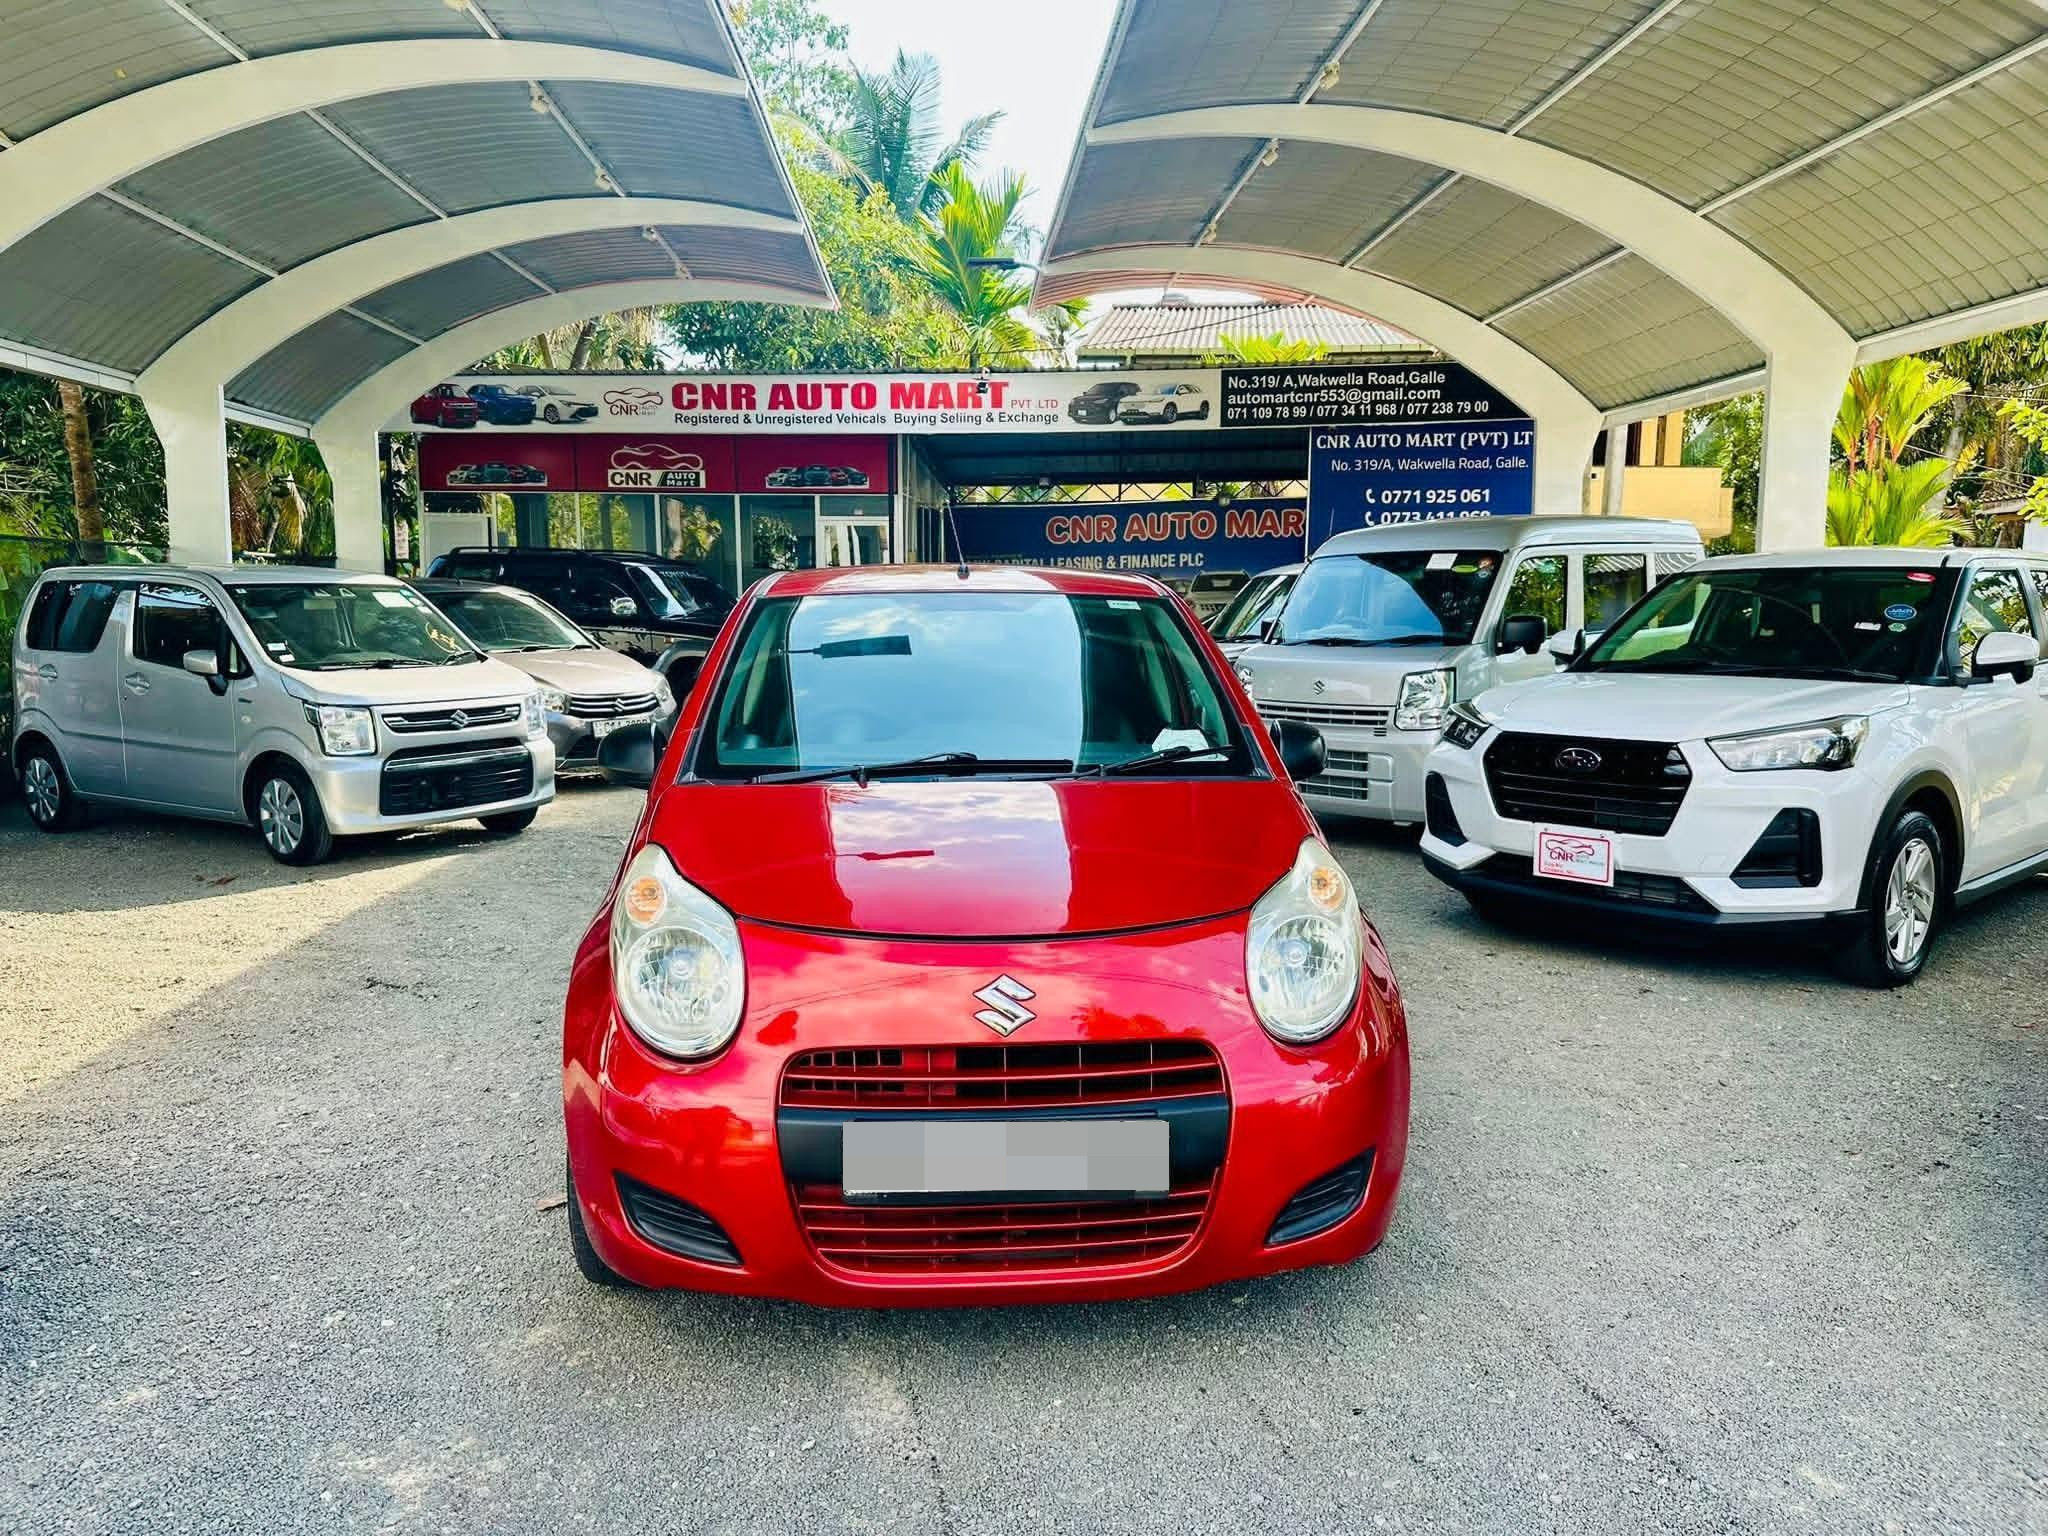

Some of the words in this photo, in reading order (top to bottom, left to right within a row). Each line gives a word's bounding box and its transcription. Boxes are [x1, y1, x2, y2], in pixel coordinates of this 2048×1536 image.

[1228, 375, 1280, 388] No.319/
[1283, 372, 1363, 389] A,Wakwella
[1368, 371, 1446, 386] Road,Galle
[672, 383, 756, 410] CNR
[767, 383, 877, 410] AUTO
[890, 382, 1009, 409] MART
[1228, 387, 1441, 404] automartcnr553@gmail.com
[610, 404, 639, 416] CNR
[1011, 399, 1032, 409] PVT
[1038, 399, 1058, 409] LTD
[1227, 407, 1247, 419] 071
[1251, 407, 1272, 419] 109
[1275, 406, 1290, 418] 78
[1292, 406, 1307, 418] 99
[1309, 405, 1314, 418] /
[1317, 405, 1338, 417] 077
[1341, 404, 1355, 416] 34
[1360, 404, 1371, 416] 11
[1375, 403, 1397, 415] 968
[1399, 403, 1404, 415] /
[1407, 402, 1428, 415] 077
[1432, 402, 1454, 414] 238
[1457, 401, 1471, 413] 79
[1474, 401, 1489, 413] 00
[674, 413, 738, 425] Registered
[743, 414, 751, 424] &
[755, 413, 832, 426] Unregistered
[836, 413, 886, 424] Vehicals
[893, 413, 936, 426] Buying
[985, 412, 994, 423] &
[999, 411, 1059, 424] Exchange
[1316, 434, 1351, 448] CNR
[1354, 433, 1401, 448] AUTO
[1406, 433, 1456, 447] MART
[1460, 431, 1508, 450] (PVT)
[1331, 459, 1351, 471] No.
[1354, 458, 1394, 472] 319/A,
[1397, 457, 1455, 470] Wakwella
[1459, 457, 1493, 470] Road,
[1495, 456, 1529, 469] Galle.
[610, 471, 652, 486] CNR
[666, 472, 696, 480] AUTO
[1381, 490, 1420, 504] 0771
[1425, 489, 1456, 504] 925
[1460, 488, 1490, 503] 061
[1047, 515, 1118, 544] CNR
[1123, 512, 1217, 541] AUTO
[1050, 556, 1103, 569] LEASING
[1106, 554, 1117, 569] &
[1120, 553, 1176, 569] FINANCE
[1179, 552, 1204, 567] PLC
[1550, 850, 1574, 862] CNR
